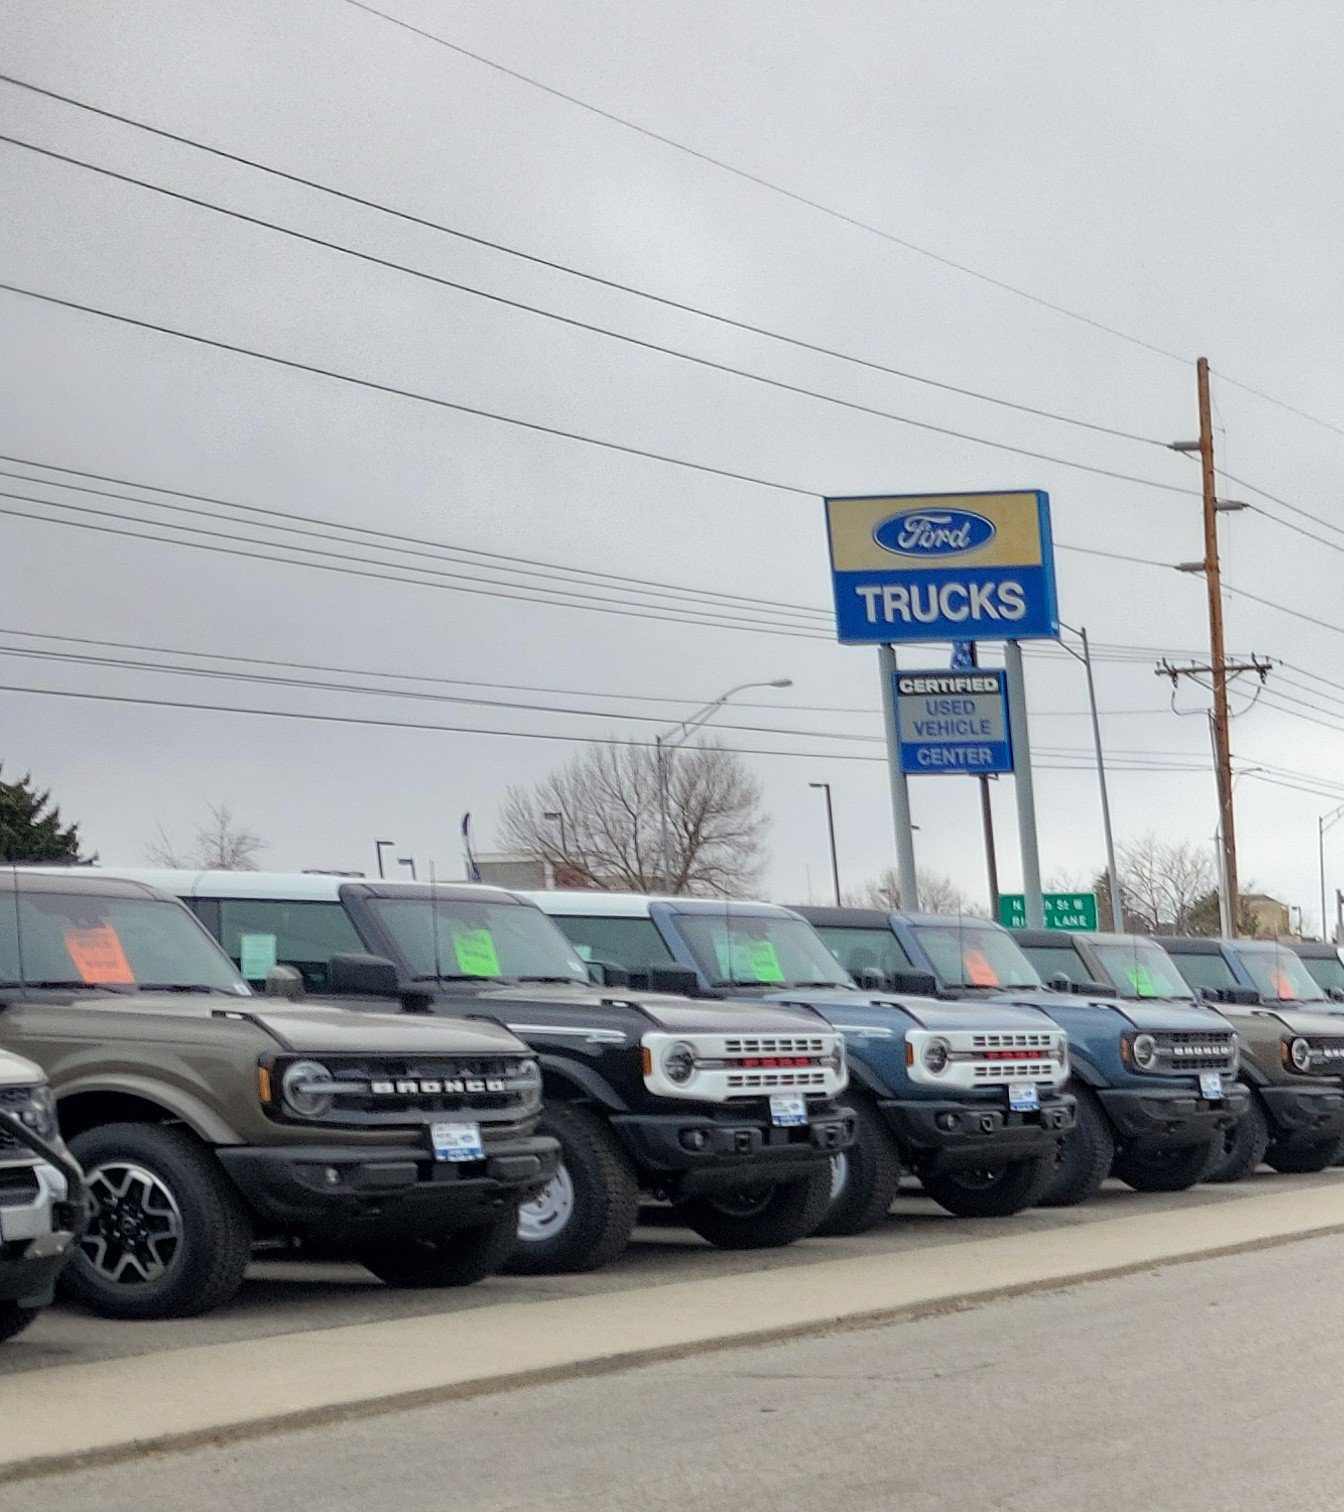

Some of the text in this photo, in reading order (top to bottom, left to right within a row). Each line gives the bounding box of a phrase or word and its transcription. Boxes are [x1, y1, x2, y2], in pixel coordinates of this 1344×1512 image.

[897, 514, 971, 549] Ford
[855, 581, 1027, 624] TRUCKS
[899, 675, 999, 693] CERTIFIED
[924, 699, 976, 716] USED
[912, 719, 992, 737] VEHICLE
[916, 747, 993, 766] CENTER
[1053, 914, 1089, 927] LANE
[371, 1079, 505, 1094] BRONCO
